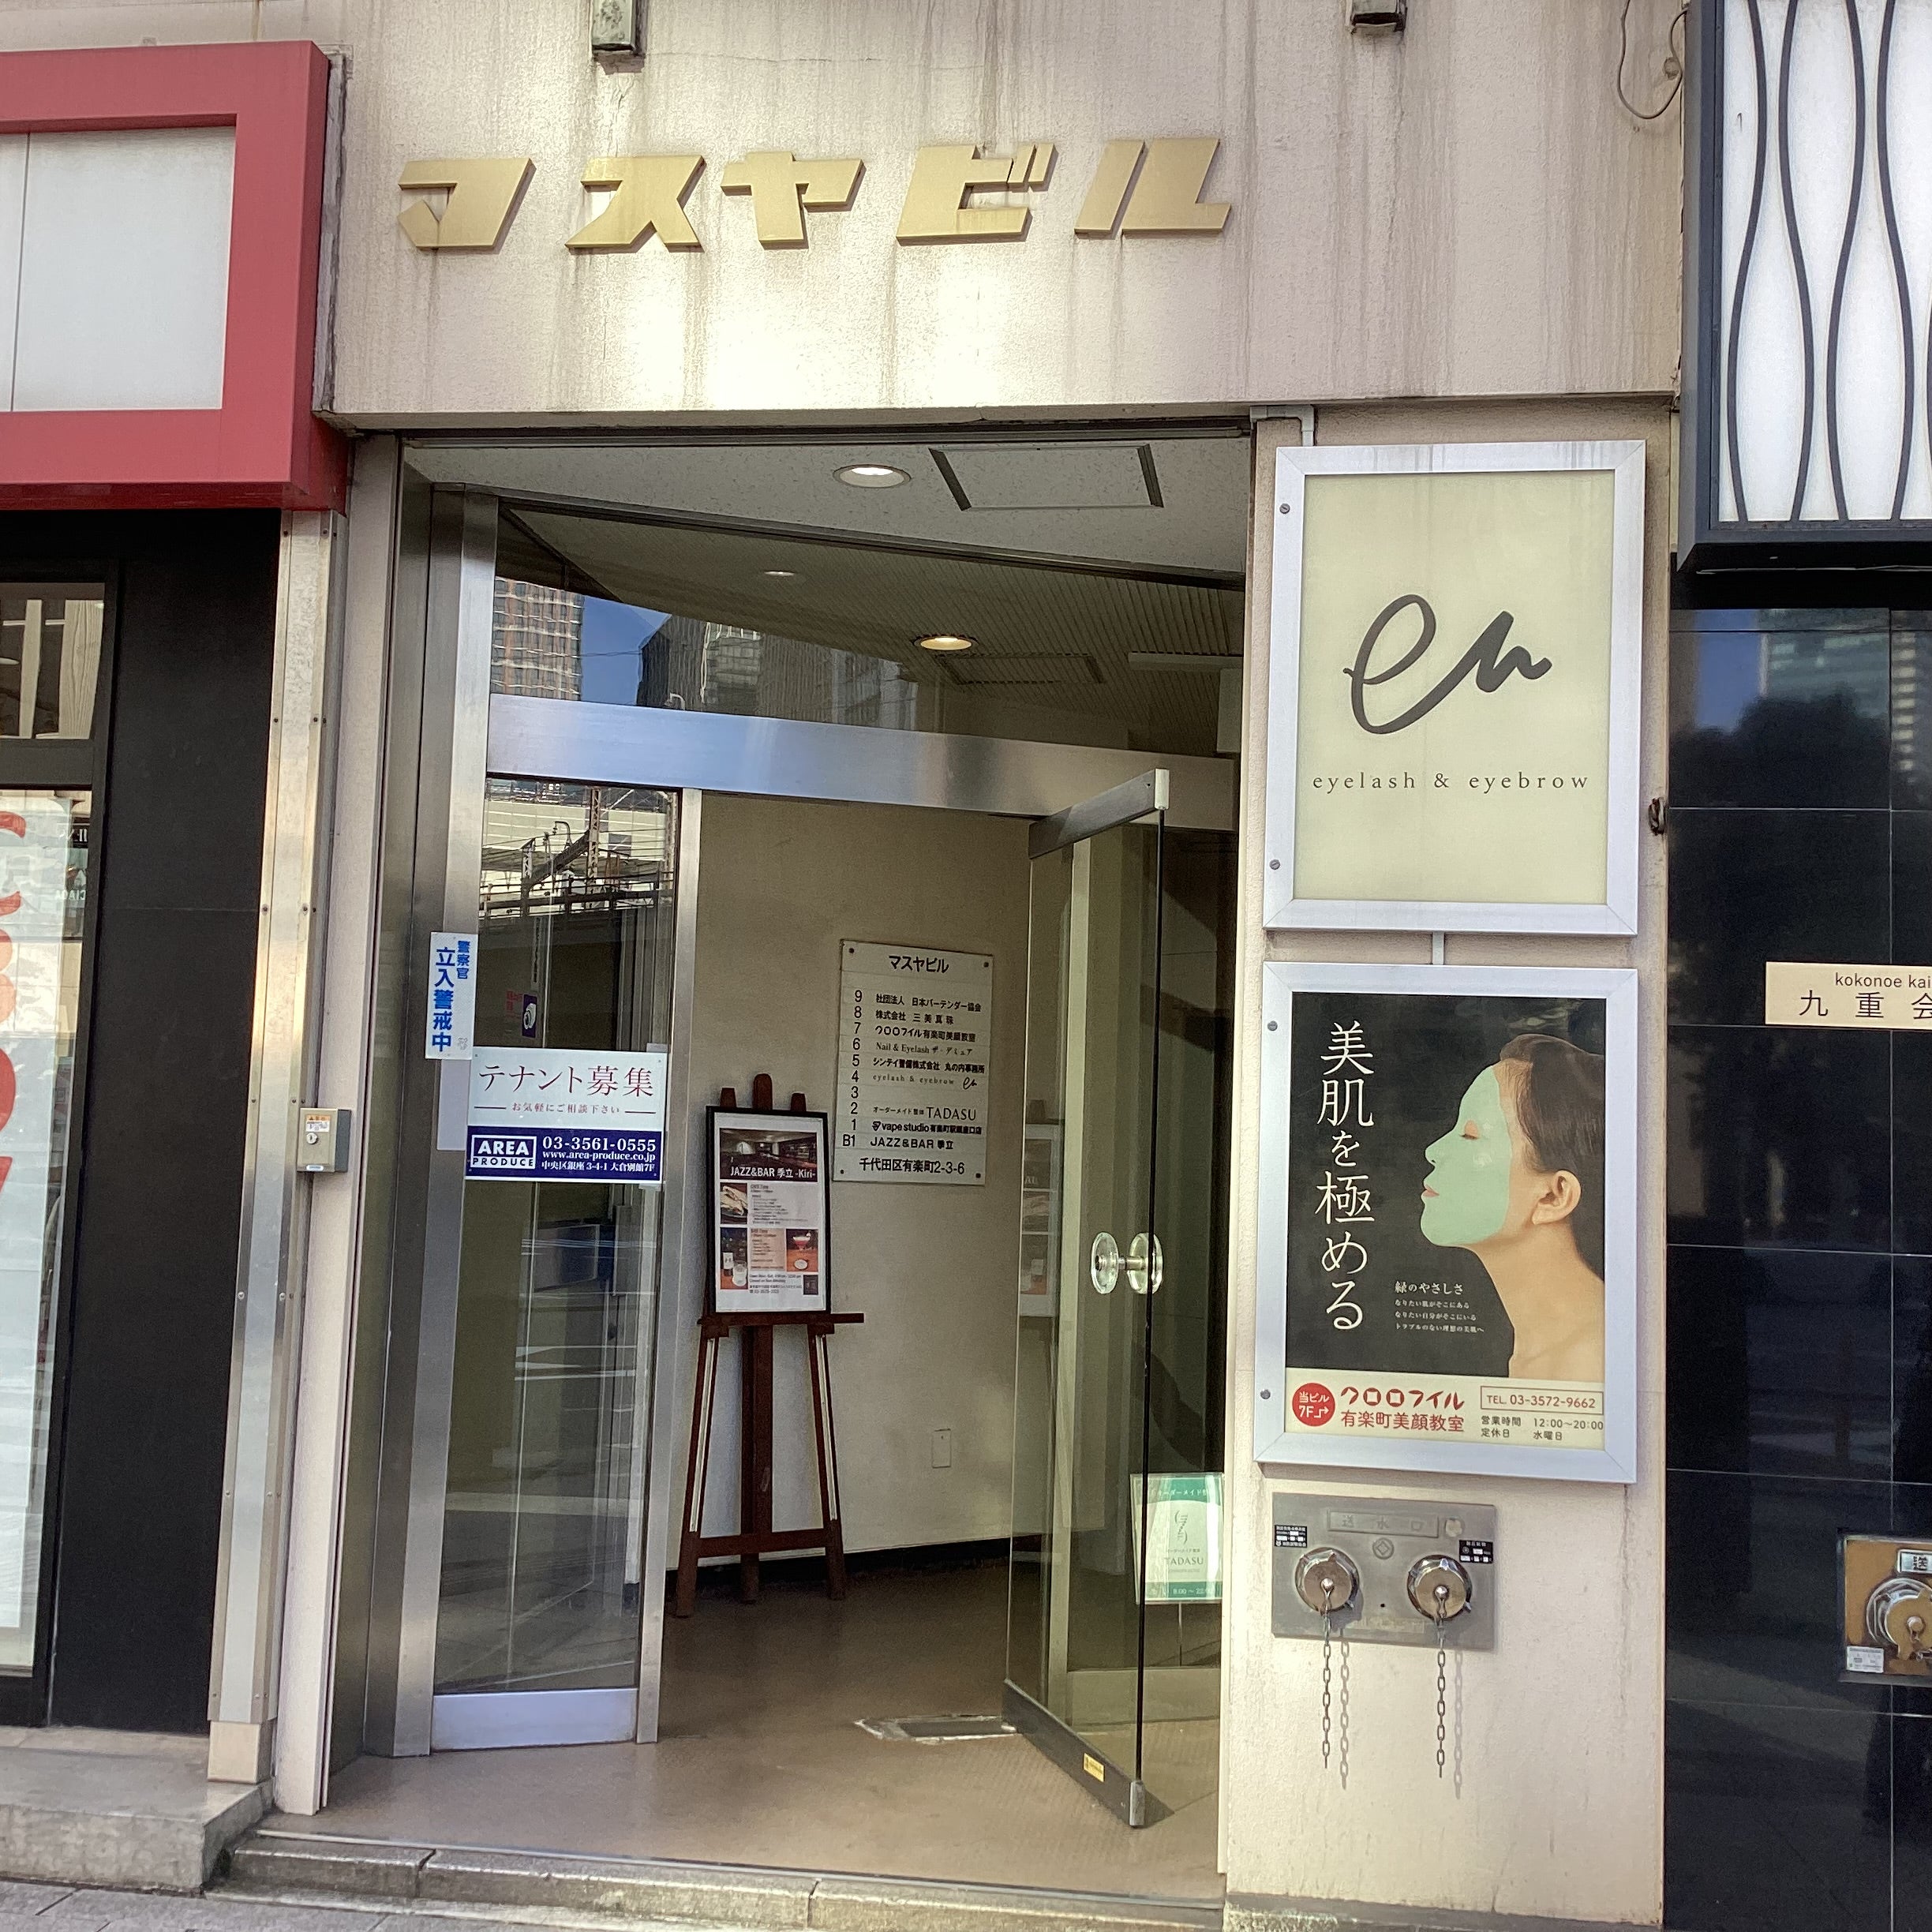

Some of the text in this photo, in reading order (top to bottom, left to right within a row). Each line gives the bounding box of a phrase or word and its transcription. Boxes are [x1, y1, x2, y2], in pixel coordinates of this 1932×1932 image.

[398, 137, 1231, 251] マスヤビル
[1312, 772, 1588, 794] eyelash & eyebrow
[456, 941, 470, 979] 警察官
[889, 955, 949, 974] マスヤビル
[1835, 972, 1903, 988] kokonoe
[432, 947, 455, 1052] 立入警戒中
[855, 990, 863, 1003] 9
[854, 1005, 863, 1019] 8
[875, 1009, 906, 1021] 株式会社
[854, 1021, 862, 1035] 7
[852, 1037, 861, 1050] 6
[876, 1042, 891, 1051] Nail
[901, 1044, 930, 1054] Eyelash
[852, 1054, 860, 1067] 5
[478, 1065, 654, 1097] テナント募集
[851, 1069, 859, 1083] 4
[851, 1085, 859, 1099] 3
[512, 1102, 620, 1114] お気軽にご相談下さい
[850, 1101, 859, 1114] 2
[926, 1106, 976, 1121] TADASU
[852, 1118, 856, 1131] 1
[882, 1123, 902, 1133] vape
[903, 1123, 930, 1133] studio
[542, 1136, 657, 1152] 03-3561-0555
[842, 1134, 856, 1147] B1
[870, 1136, 934, 1149] JAZZ&BAR
[477, 1140, 530, 1155] AREA
[473, 1157, 534, 1166] PRODUCE
[542, 1151, 656, 1162] www.area-produce.co.jp
[586, 1162, 608, 1171] 3-4-1
[730, 1166, 775, 1178] JAZZ&BAR
[1315, 1020, 1376, 1331] 美肌を極める
[1395, 1281, 1463, 1295] 緑のやさしさ
[1298, 1391, 1330, 1404] 当ビル
[1510, 1395, 1596, 1409] 03-3572-9662
[1298, 1406, 1314, 1418] 7F
[1341, 1410, 1464, 1432] 有楽町美顔教室
[1481, 1416, 1521, 1427] 営業時間
[1481, 1428, 1563, 1441] 定休日 水曜日
